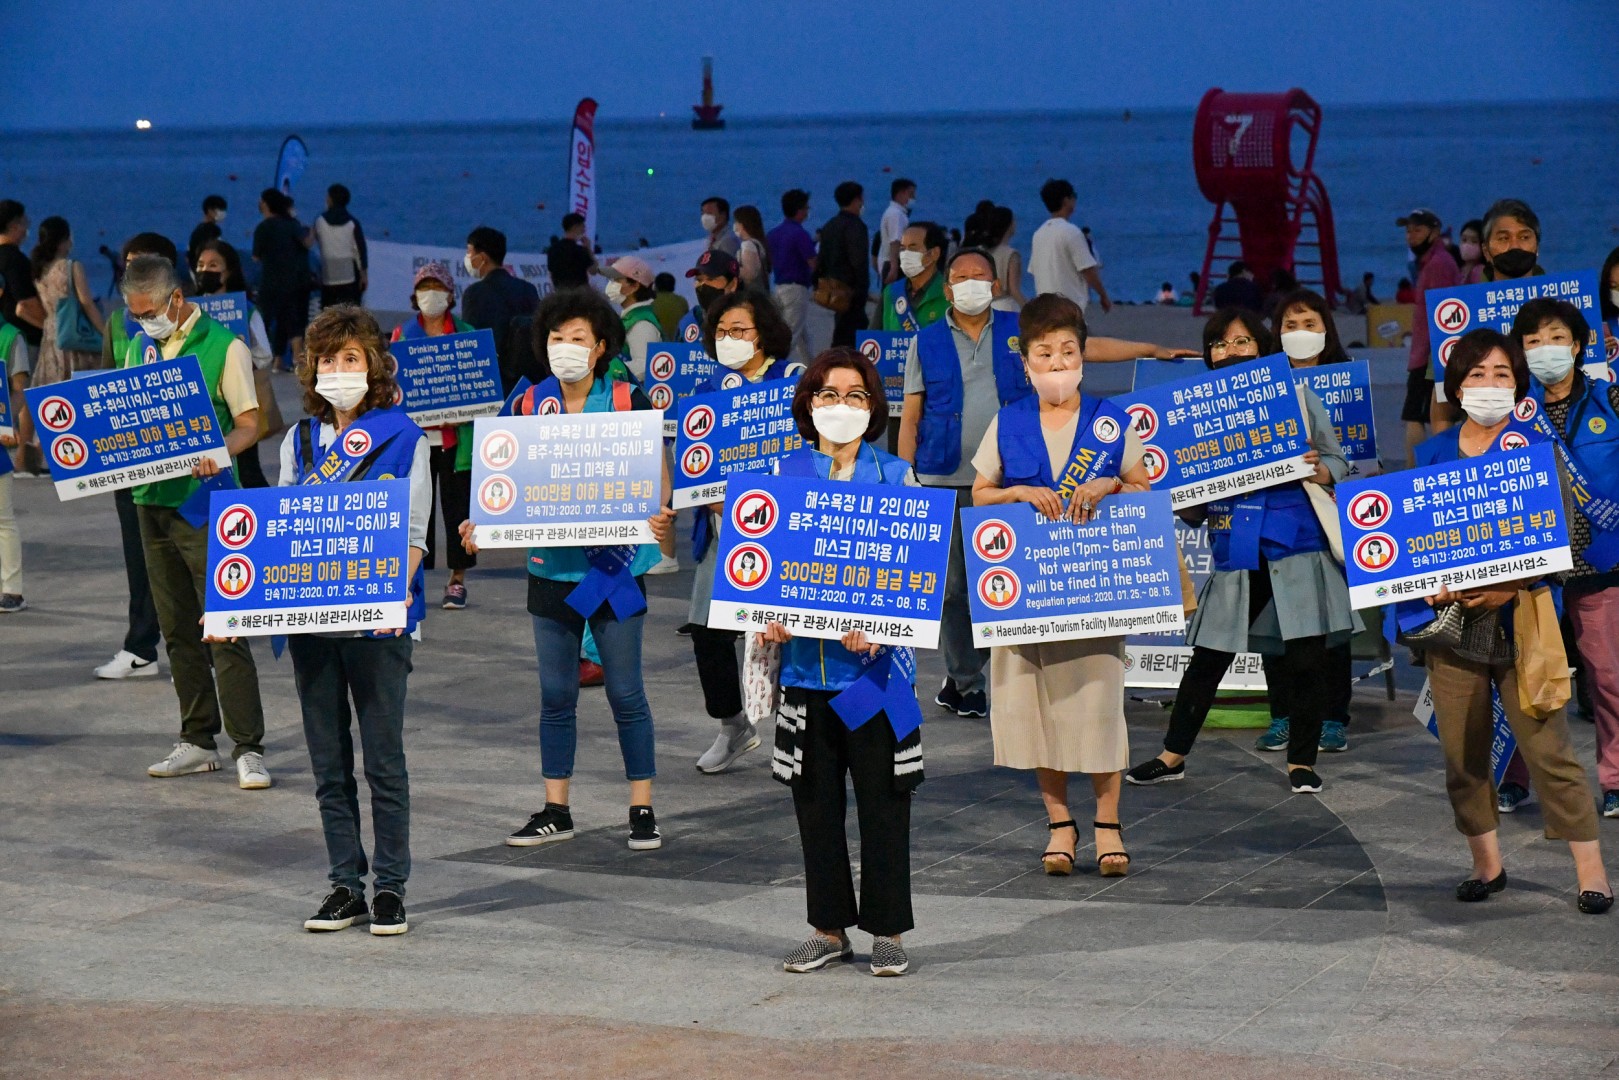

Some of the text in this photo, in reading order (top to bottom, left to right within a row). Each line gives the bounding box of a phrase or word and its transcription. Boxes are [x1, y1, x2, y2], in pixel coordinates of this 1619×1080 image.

[1224, 114, 1254, 154] 7
[700, 251, 711, 265] B
[1485, 279, 1579, 304] 해수욕장 내 2인 이상
[1582, 294, 1592, 308] 및
[408, 344, 438, 355] Drinking
[454, 339, 478, 349] Eating
[417, 350, 472, 364] with more than
[87, 366, 182, 399] 해수욕장 내 2인 이상
[405, 378, 494, 397] will be fined in the beach
[412, 376, 425, 386] Not
[426, 373, 456, 384] wearing
[463, 369, 483, 379] mask
[1172, 366, 1271, 405] 해수욕장 내 2인 이상
[1313, 371, 1351, 389] 2인 이상
[732, 390, 766, 409] 해수욕장
[769, 387, 778, 402] 내
[1354, 387, 1363, 401] 및
[92, 414, 212, 453] 300만원 이하 벌금 부과
[541, 422, 643, 441] 해수욕장 내 2인 이상
[740, 417, 793, 440] 마스크 미착용
[1347, 423, 1368, 441] 부과
[718, 433, 802, 463] 300만원 이하 벌금
[1173, 418, 1298, 464] 300만원 이하 벌금 부과
[1092, 450, 1109, 472] Inside
[1056, 447, 1097, 499] WEAR
[1206, 463, 1295, 494] 관광시설관리사업소
[1412, 455, 1531, 492] 해수욕장 내 2인 이상
[279, 490, 388, 514] 해수욕장 내 2인 이상
[524, 481, 653, 502] 300만원 이하 벌금 부과
[805, 490, 929, 518] 해수욕장 내 2인 이상
[1109, 503, 1145, 519] Eating
[1432, 495, 1523, 527] 마스크 미착용 시
[503, 525, 638, 541] 해운대구 관광시설관리사업소
[928, 523, 941, 542] 및
[1048, 522, 1136, 540] with more than
[1406, 509, 1556, 554] 300만원 이하 벌금 부과
[290, 535, 373, 557] 마스크 미착용 시
[813, 537, 909, 563] 마스크 미착용 시
[1032, 543, 1070, 560] people
[1143, 534, 1163, 549] and
[262, 556, 399, 584] 300만원 이하 벌금 부과
[1038, 553, 1152, 575] Not wearing a mask
[1184, 554, 1212, 574] 스크
[1390, 555, 1548, 594] 해운대구 관광시설관리사업소
[779, 560, 936, 593] 300만원 이하 벌금 부과
[1026, 568, 1169, 593] will be fined in the beach
[896, 595, 911, 609] 08.
[916, 597, 929, 611] 15.
[241, 608, 383, 628] 해운대구 관광시설관리사업소
[996, 610, 1177, 637] Haeundae-gu Tourism Facility Management Office
